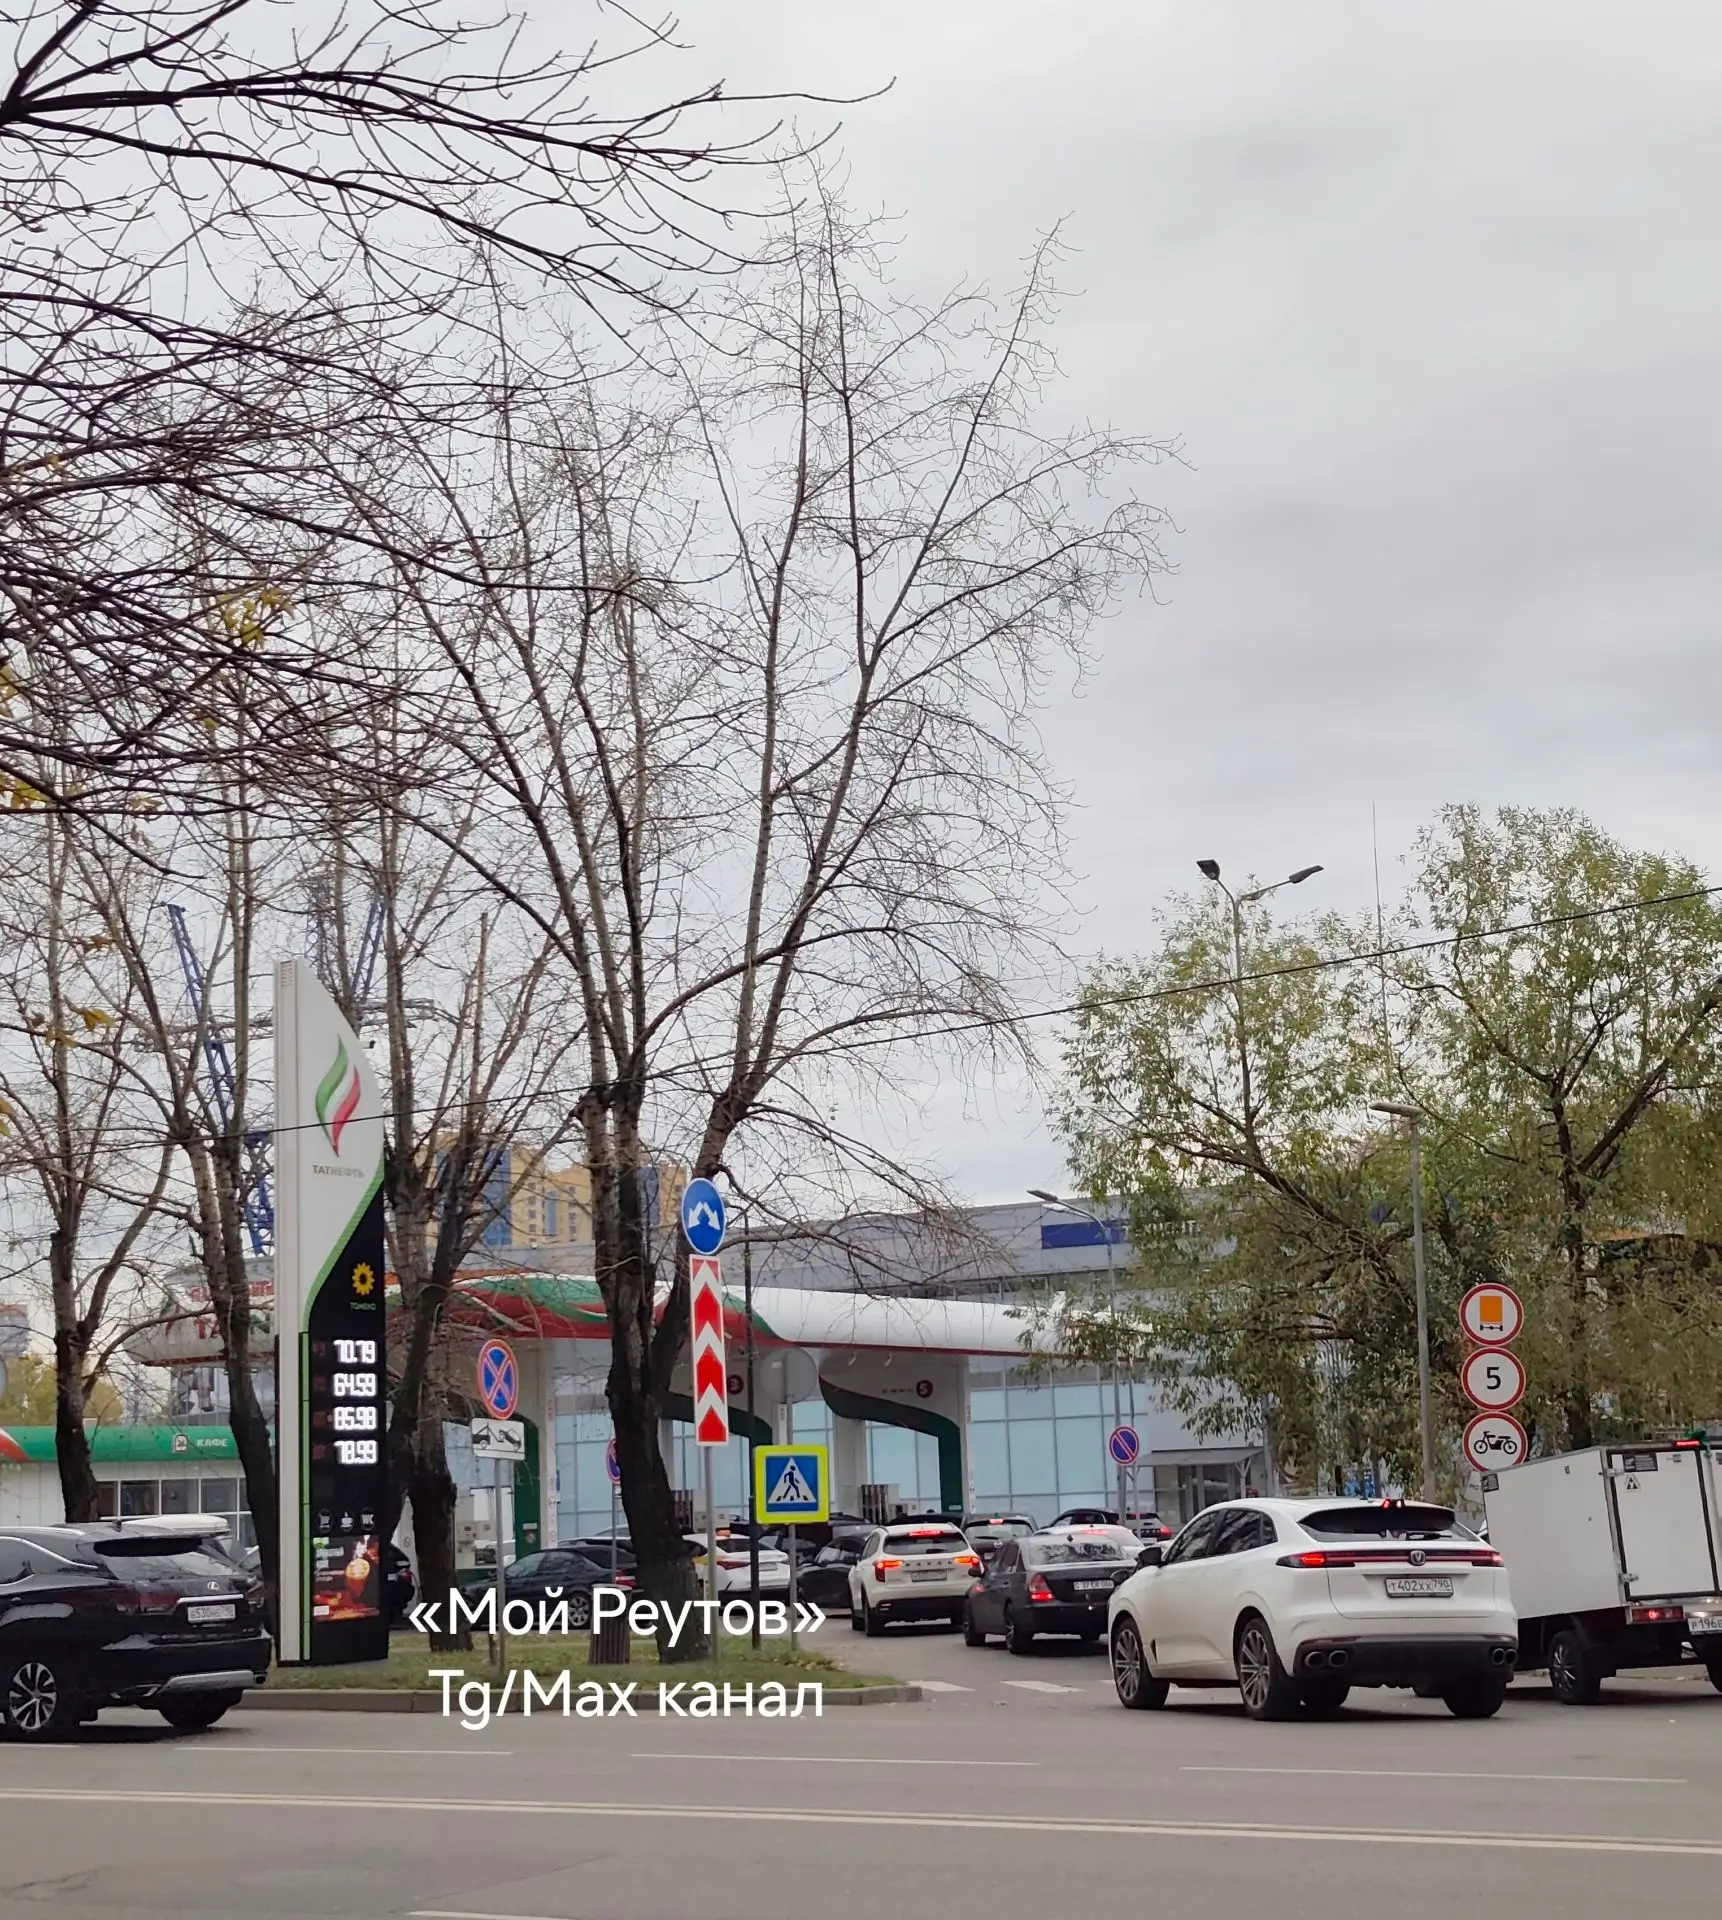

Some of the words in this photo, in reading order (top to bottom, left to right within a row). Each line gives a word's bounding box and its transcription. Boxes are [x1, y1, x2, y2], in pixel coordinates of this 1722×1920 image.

[312, 1165, 365, 1178] ТАТНЕФТЬ
[1487, 1367, 1501, 1390] 5
[196, 1438, 228, 1447] КАФЕ
